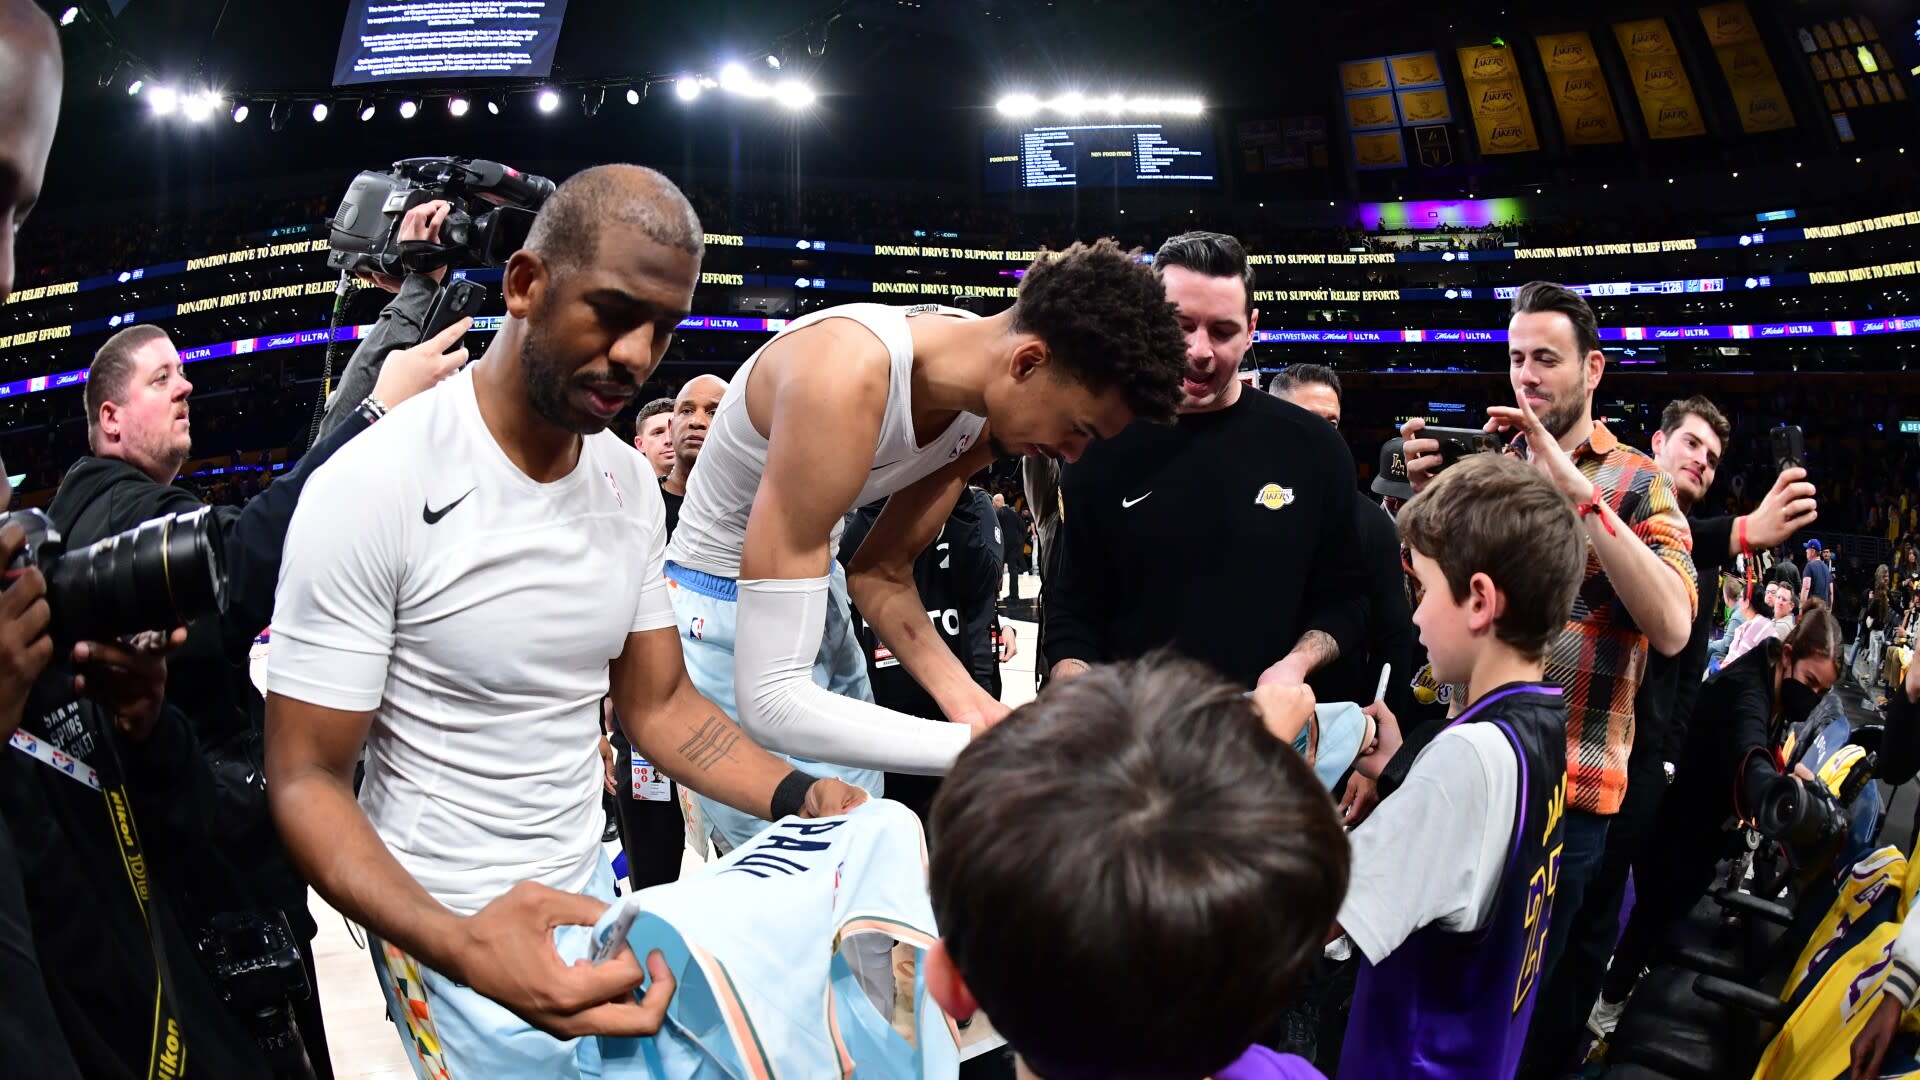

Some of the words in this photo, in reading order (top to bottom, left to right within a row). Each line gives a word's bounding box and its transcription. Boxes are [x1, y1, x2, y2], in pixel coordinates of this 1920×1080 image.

[1803, 224, 1842, 240] DONATION
[1841, 220, 1864, 235] DRIVE
[1863, 219, 1875, 230] TO
[1875, 213, 1905, 229] SUPPORT
[704, 233, 744, 246] EFFORTS
[186, 253, 229, 271] DONATION
[229, 248, 255, 263] DRIVE
[257, 246, 269, 259] TO
[269, 241, 310, 257] SUPPORT
[874, 245, 920, 256] DONATION
[921, 247, 949, 257] DRIVE
[951, 249, 963, 258] TO
[964, 249, 1004, 261] SUPPORT
[1514, 248, 1555, 259] DONATION
[1556, 246, 1582, 258] DRIVE
[1582, 245, 1594, 256] TO
[1594, 243, 1631, 255] SUPPORT
[1632, 241, 1660, 253] RELIEF
[1661, 239, 1697, 252] EFFORTS
[1274, 254, 1286, 264] TO
[1287, 254, 1326, 264] SUPPORT
[1327, 254, 1357, 265] RELIEF
[1358, 253, 1395, 264] EFFORTS
[702, 272, 744, 285] EFFORTS
[1808, 270, 1849, 285] DONATION
[1849, 267, 1872, 281] DRIVE
[1871, 265, 1883, 279] TO
[1882, 261, 1915, 276] SUPPORT
[21, 287, 46, 301] RELIEF
[46, 282, 79, 297] EFFORTS
[872, 282, 919, 293] DONATION
[920, 284, 949, 295] DRIVE
[951, 285, 964, 295] TO
[964, 286, 1005, 298] SUPPORT
[1253, 291, 1274, 301] RIVE
[1275, 291, 1288, 301] TO
[1289, 291, 1329, 301] SUPPORT
[1331, 291, 1361, 301] RELIEF
[1362, 290, 1400, 301] EFFORTS
[1598, 285, 1614, 295] 0.0
[176, 297, 219, 315] DONATION
[219, 292, 246, 308] DRIVE
[248, 290, 261, 302] TO
[261, 284, 303, 301] SUPPORT
[304, 280, 338, 295] RELIEF
[710, 319, 739, 328] ULTRA
[1789, 325, 1814, 334] ULTRA
[12, 331, 38, 346] RELIEF
[38, 325, 72, 341] EFFORTS
[301, 331, 329, 343] ULTRA
[1354, 332, 1380, 340] ULTRA
[1465, 332, 1492, 340] ULTRA
[1684, 328, 1710, 338] ULTRA
[185, 348, 211, 360] ULTRA
[50, 714, 83, 750] SPURS
[111, 791, 134, 847] Nikon
[715, 819, 849, 879] PAUL
